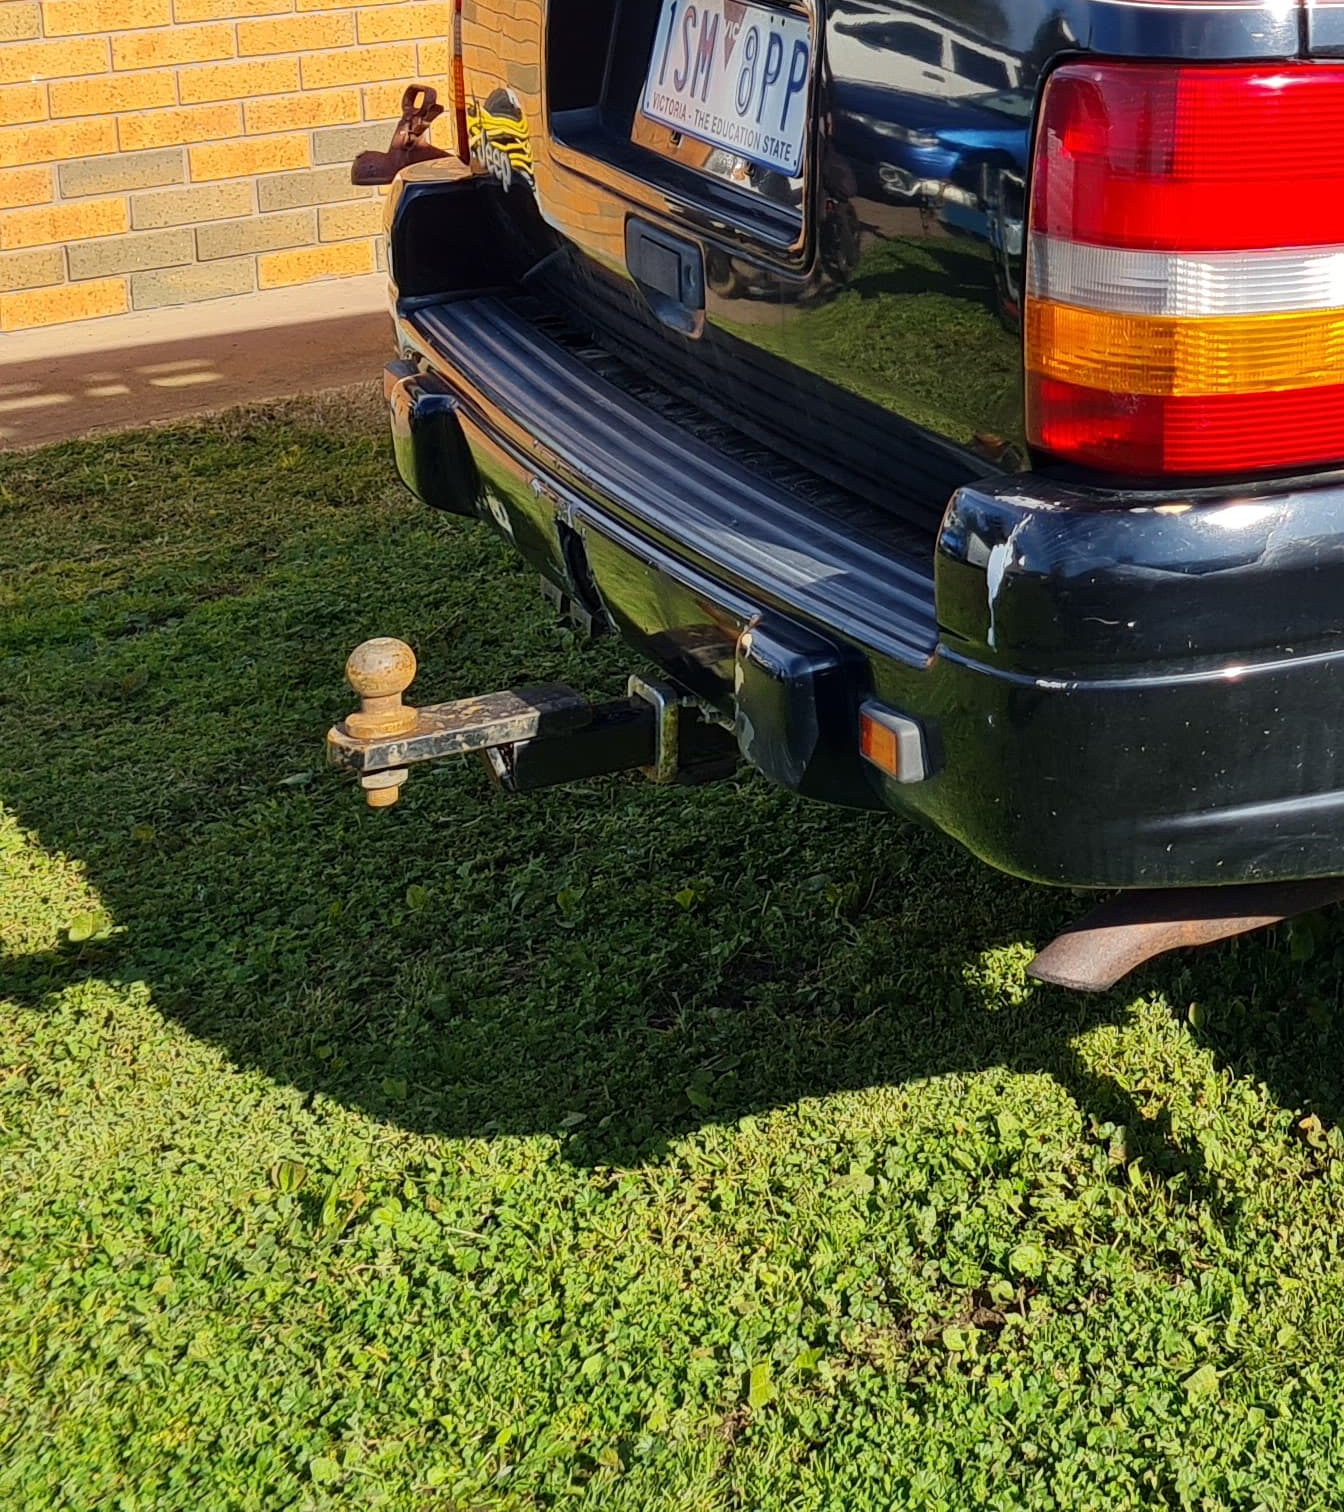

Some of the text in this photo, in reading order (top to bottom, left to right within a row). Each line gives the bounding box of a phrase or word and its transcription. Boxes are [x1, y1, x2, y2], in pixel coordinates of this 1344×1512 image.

[659, 0, 809, 131] 1SM 8PP
[652, 91, 688, 121] VICTORIA
[694, 108, 711, 130] THE
[711, 116, 761, 150] EDUCATION
[762, 135, 793, 162] STATE
